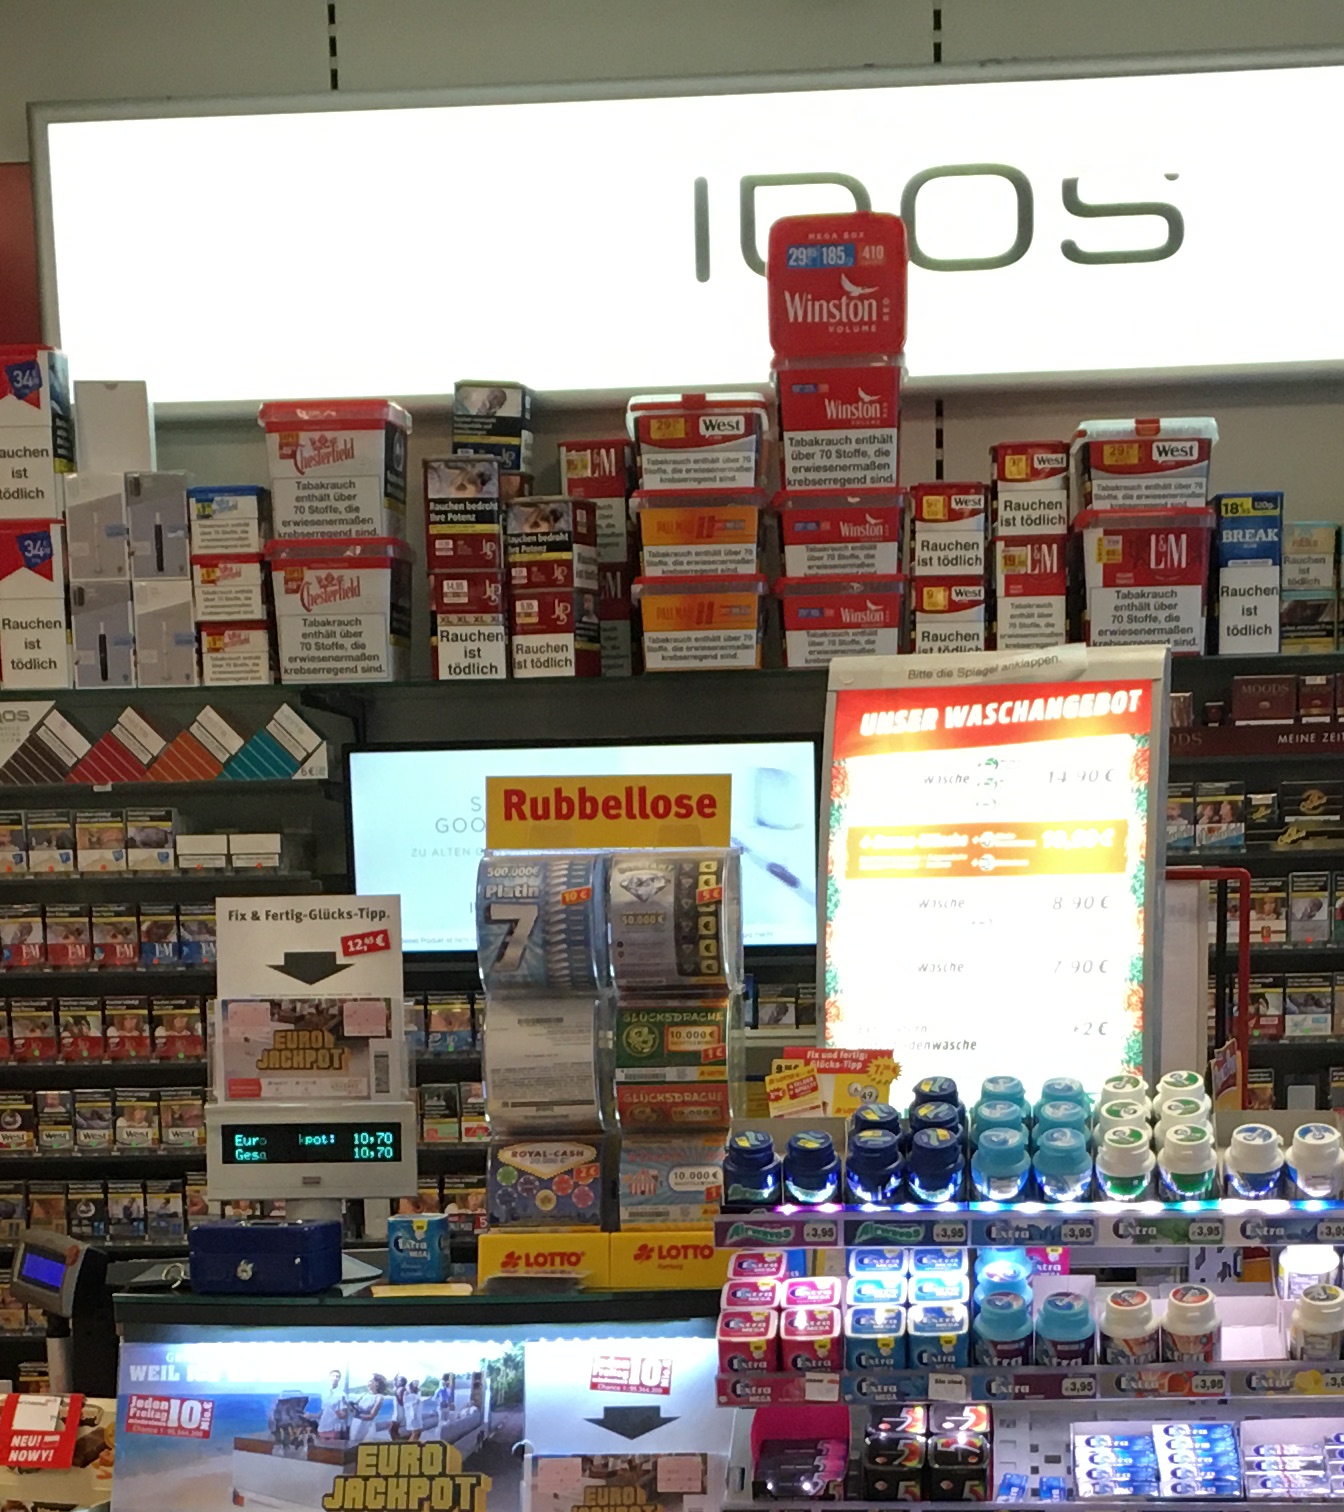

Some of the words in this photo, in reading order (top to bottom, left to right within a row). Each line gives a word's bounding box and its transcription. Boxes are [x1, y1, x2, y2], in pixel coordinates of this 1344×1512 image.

[784, 290, 877, 323] Winston
[828, 325, 876, 334] VOLUME
[825, 398, 881, 420] Winston
[701, 416, 743, 434] West
[788, 434, 852, 449] Tabakrauch
[855, 433, 894, 448] enthält
[294, 436, 355, 475] Chesterfield
[791, 447, 817, 461] über
[819, 448, 833, 461] 70
[836, 447, 870, 462] Stoffe,
[872, 446, 891, 459] die
[1156, 442, 1196, 459] West
[11, 467, 29, 480] ist
[792, 460, 891, 475] erwiesenermaßen
[295, 480, 356, 492] Tabakrauch
[787, 474, 857, 489] krebserregend
[294, 492, 330, 504] enthält
[333, 492, 357, 504] über
[1003, 498, 1063, 513] Rauchen
[293, 505, 306, 516] 70
[308, 504, 343, 518] Stoffe,
[344, 503, 361, 515] die
[450, 511, 476, 523] Potenz
[281, 515, 374, 528] erwiesenermaßen
[1222, 528, 1278, 544] BREAK
[921, 539, 980, 554] Rauchen
[300, 573, 361, 612] Chesterfield
[1241, 604, 1258, 617] ist
[2, 617, 62, 631] Rauchen
[1226, 622, 1273, 638] tödlich
[24, 637, 41, 650] ist
[439, 629, 504, 645] Rauchen
[11, 656, 58, 671] tödlich
[447, 660, 501, 677] tödlich
[907, 667, 934, 680] Bitte
[936, 667, 954, 679] die
[957, 664, 999, 680] Spiegel
[1001, 655, 1063, 673] anklappen.
[1241, 682, 1290, 696] MOODS
[860, 707, 939, 737] UNSER
[945, 689, 1143, 729] WASCHANGEBOT
[1277, 732, 1317, 745] MEINE
[503, 786, 718, 821] Rubbellose
[429, 847, 475, 858] ALTEN
[485, 883, 540, 900] Platin
[227, 909, 247, 922] Fix
[250, 910, 261, 922] &
[265, 907, 391, 924] Fertig-Glücks-Tipp.
[485, 902, 539, 974] 7
[273, 1029, 320, 1049] EURO
[669, 1029, 707, 1041] 10.000
[256, 1049, 344, 1071] JACKPOT
[1196, 1224, 1221, 1237] 3,95
[524, 1251, 581, 1268] LOTTO
[657, 1244, 714, 1261] LOTTO
[129, 1364, 181, 1382] WEIL
[131, 1396, 169, 1411] Jeden
[129, 1406, 168, 1422] Freitag
[168, 1398, 202, 1429] 10
[11, 1434, 41, 1447] NEU!
[8, 1449, 54, 1463] NOWY!
[357, 1442, 444, 1476] EURO
[585, 1485, 637, 1505] EURO
